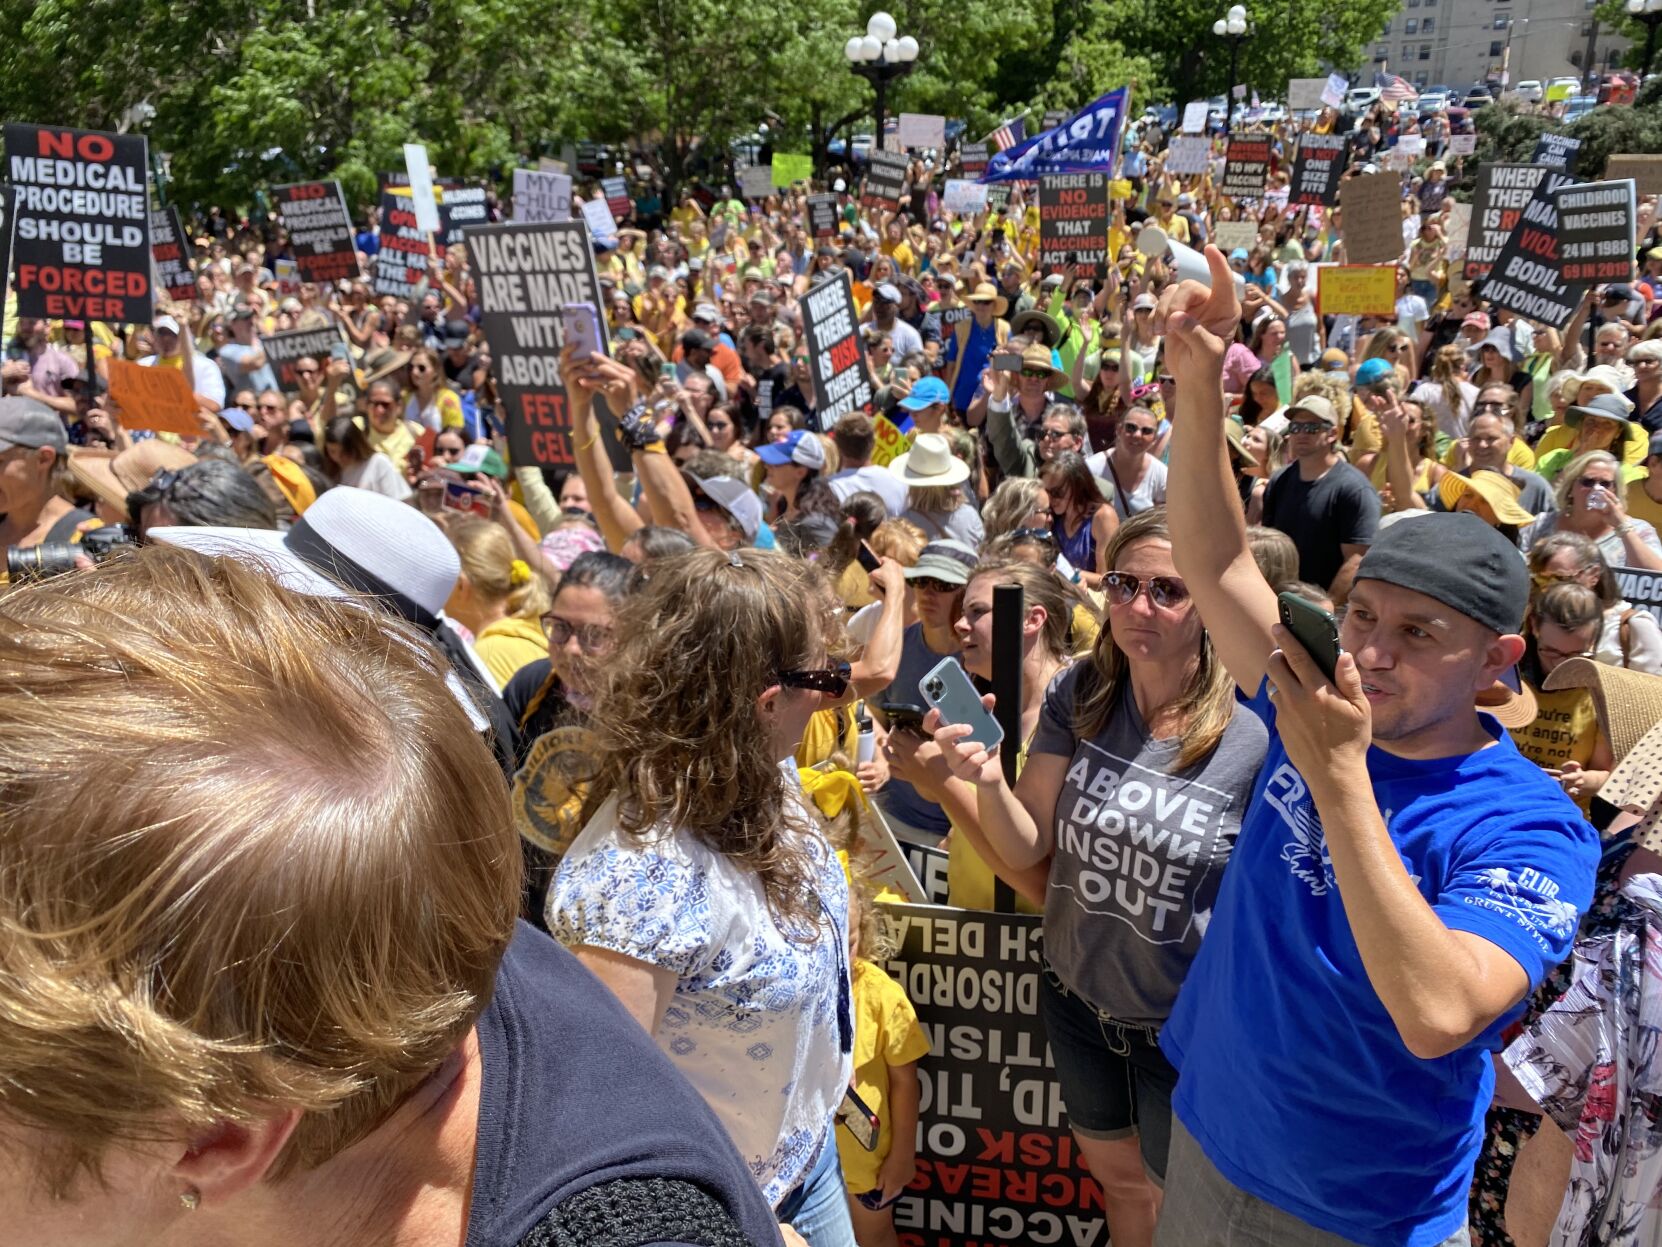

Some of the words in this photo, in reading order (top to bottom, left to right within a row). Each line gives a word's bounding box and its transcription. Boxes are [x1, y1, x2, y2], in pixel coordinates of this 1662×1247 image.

[38, 129, 114, 162] NO
[1540, 132, 1581, 149] VACCINES
[1549, 145, 1567, 157] CAN
[1229, 161, 1243, 174] TO
[1244, 162, 1265, 174] HPV
[1305, 158, 1332, 171] ONE
[1538, 152, 1568, 165] CAUSE
[11, 155, 144, 193] MEDICAL
[525, 173, 557, 192] MY
[1042, 175, 1086, 190] THERE
[1089, 173, 1104, 187] IS
[1225, 173, 1264, 187] VACCINE
[1301, 171, 1330, 184] SIZE
[289, 184, 326, 200] NO
[1059, 190, 1088, 205] NO
[1300, 181, 1327, 194] FITS
[1487, 188, 1535, 208] THER
[1558, 187, 1629, 210] CHILDHOOD
[15, 184, 146, 220] PROCEDURE
[515, 190, 571, 211] CHILD
[1042, 204, 1106, 220] EVIDENCE
[1056, 219, 1092, 236] THAT
[1482, 210, 1501, 229] IS
[1563, 210, 1627, 231] VACCINES
[18, 217, 143, 248] SHOULD
[1042, 236, 1106, 250] VACCINES
[62, 243, 102, 266] BE
[469, 230, 587, 274] VACCINES
[1043, 249, 1107, 265] ACTALLY
[1562, 242, 1579, 259] 24
[1581, 241, 1595, 258] IN
[1599, 238, 1630, 257] 1988
[19, 264, 147, 298] FORCED
[1562, 266, 1580, 280] 69
[1582, 264, 1597, 279] IN
[1599, 260, 1630, 279] 2019
[481, 275, 527, 313] ARE
[526, 272, 594, 310] MADE
[807, 278, 848, 325] WHERE
[1480, 279, 1573, 326] AUTONOMY
[46, 295, 125, 319] EVER
[813, 307, 853, 350] THERE
[263, 329, 344, 361] VACCINES
[818, 350, 833, 382] IS
[831, 335, 862, 376] RISK
[501, 355, 563, 387] ABOR
[824, 363, 863, 404] THERE
[520, 394, 573, 427] FET
[820, 392, 854, 431] MUST
[853, 380, 873, 409] BE
[875, 418, 898, 447] NO
[530, 431, 574, 464] CEL
[1532, 727, 1577, 746] angry,
[1547, 748, 1572, 759] not
[1065, 757, 1214, 837] ABOVE
[1058, 819, 1191, 900] INSIDE
[1079, 870, 1181, 932] OUT
[1464, 896, 1516, 919] GRUNT
[1516, 917, 1549, 953] STYLE
